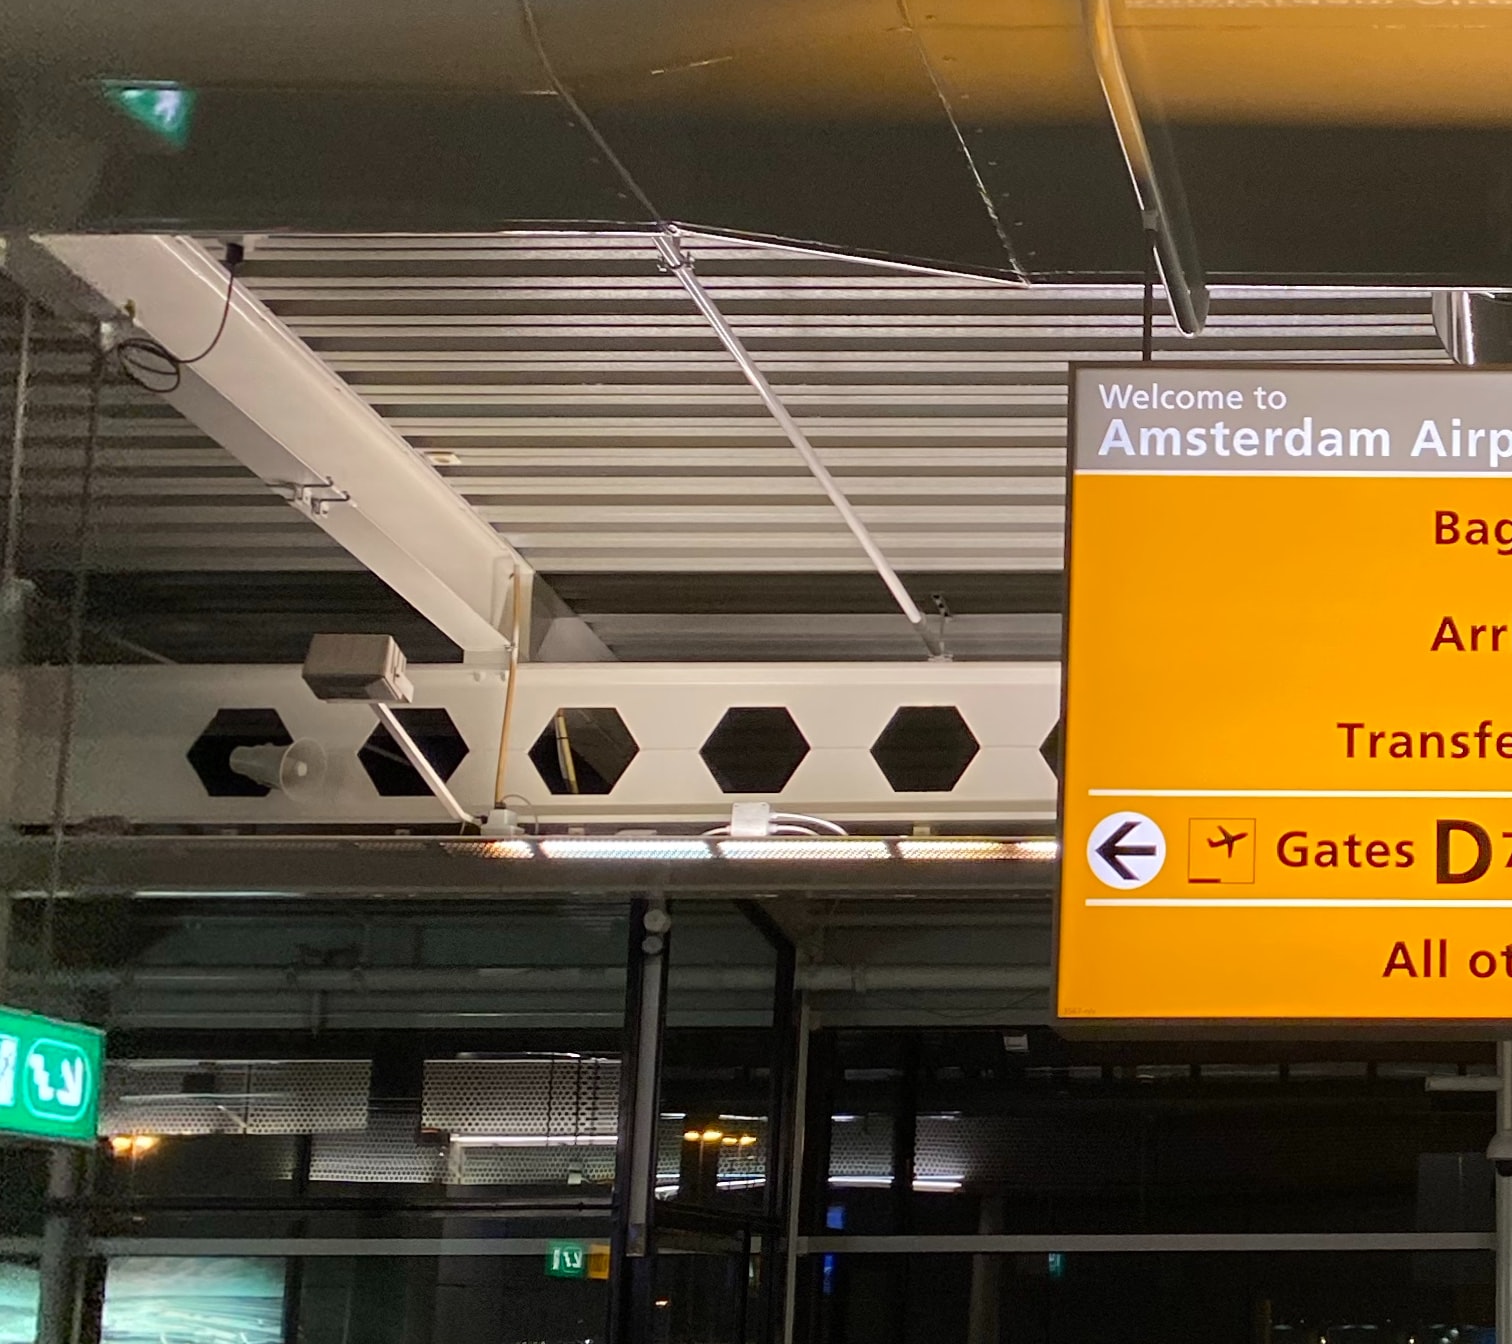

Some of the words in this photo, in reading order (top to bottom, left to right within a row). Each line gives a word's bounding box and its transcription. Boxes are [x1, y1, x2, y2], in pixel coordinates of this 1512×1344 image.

[1098, 383, 1243, 410] Welcome
[1253, 386, 1287, 410] to
[1098, 418, 1391, 458] Amsterdam
[1276, 830, 1415, 868] Gates
[1382, 938, 1447, 978] All
